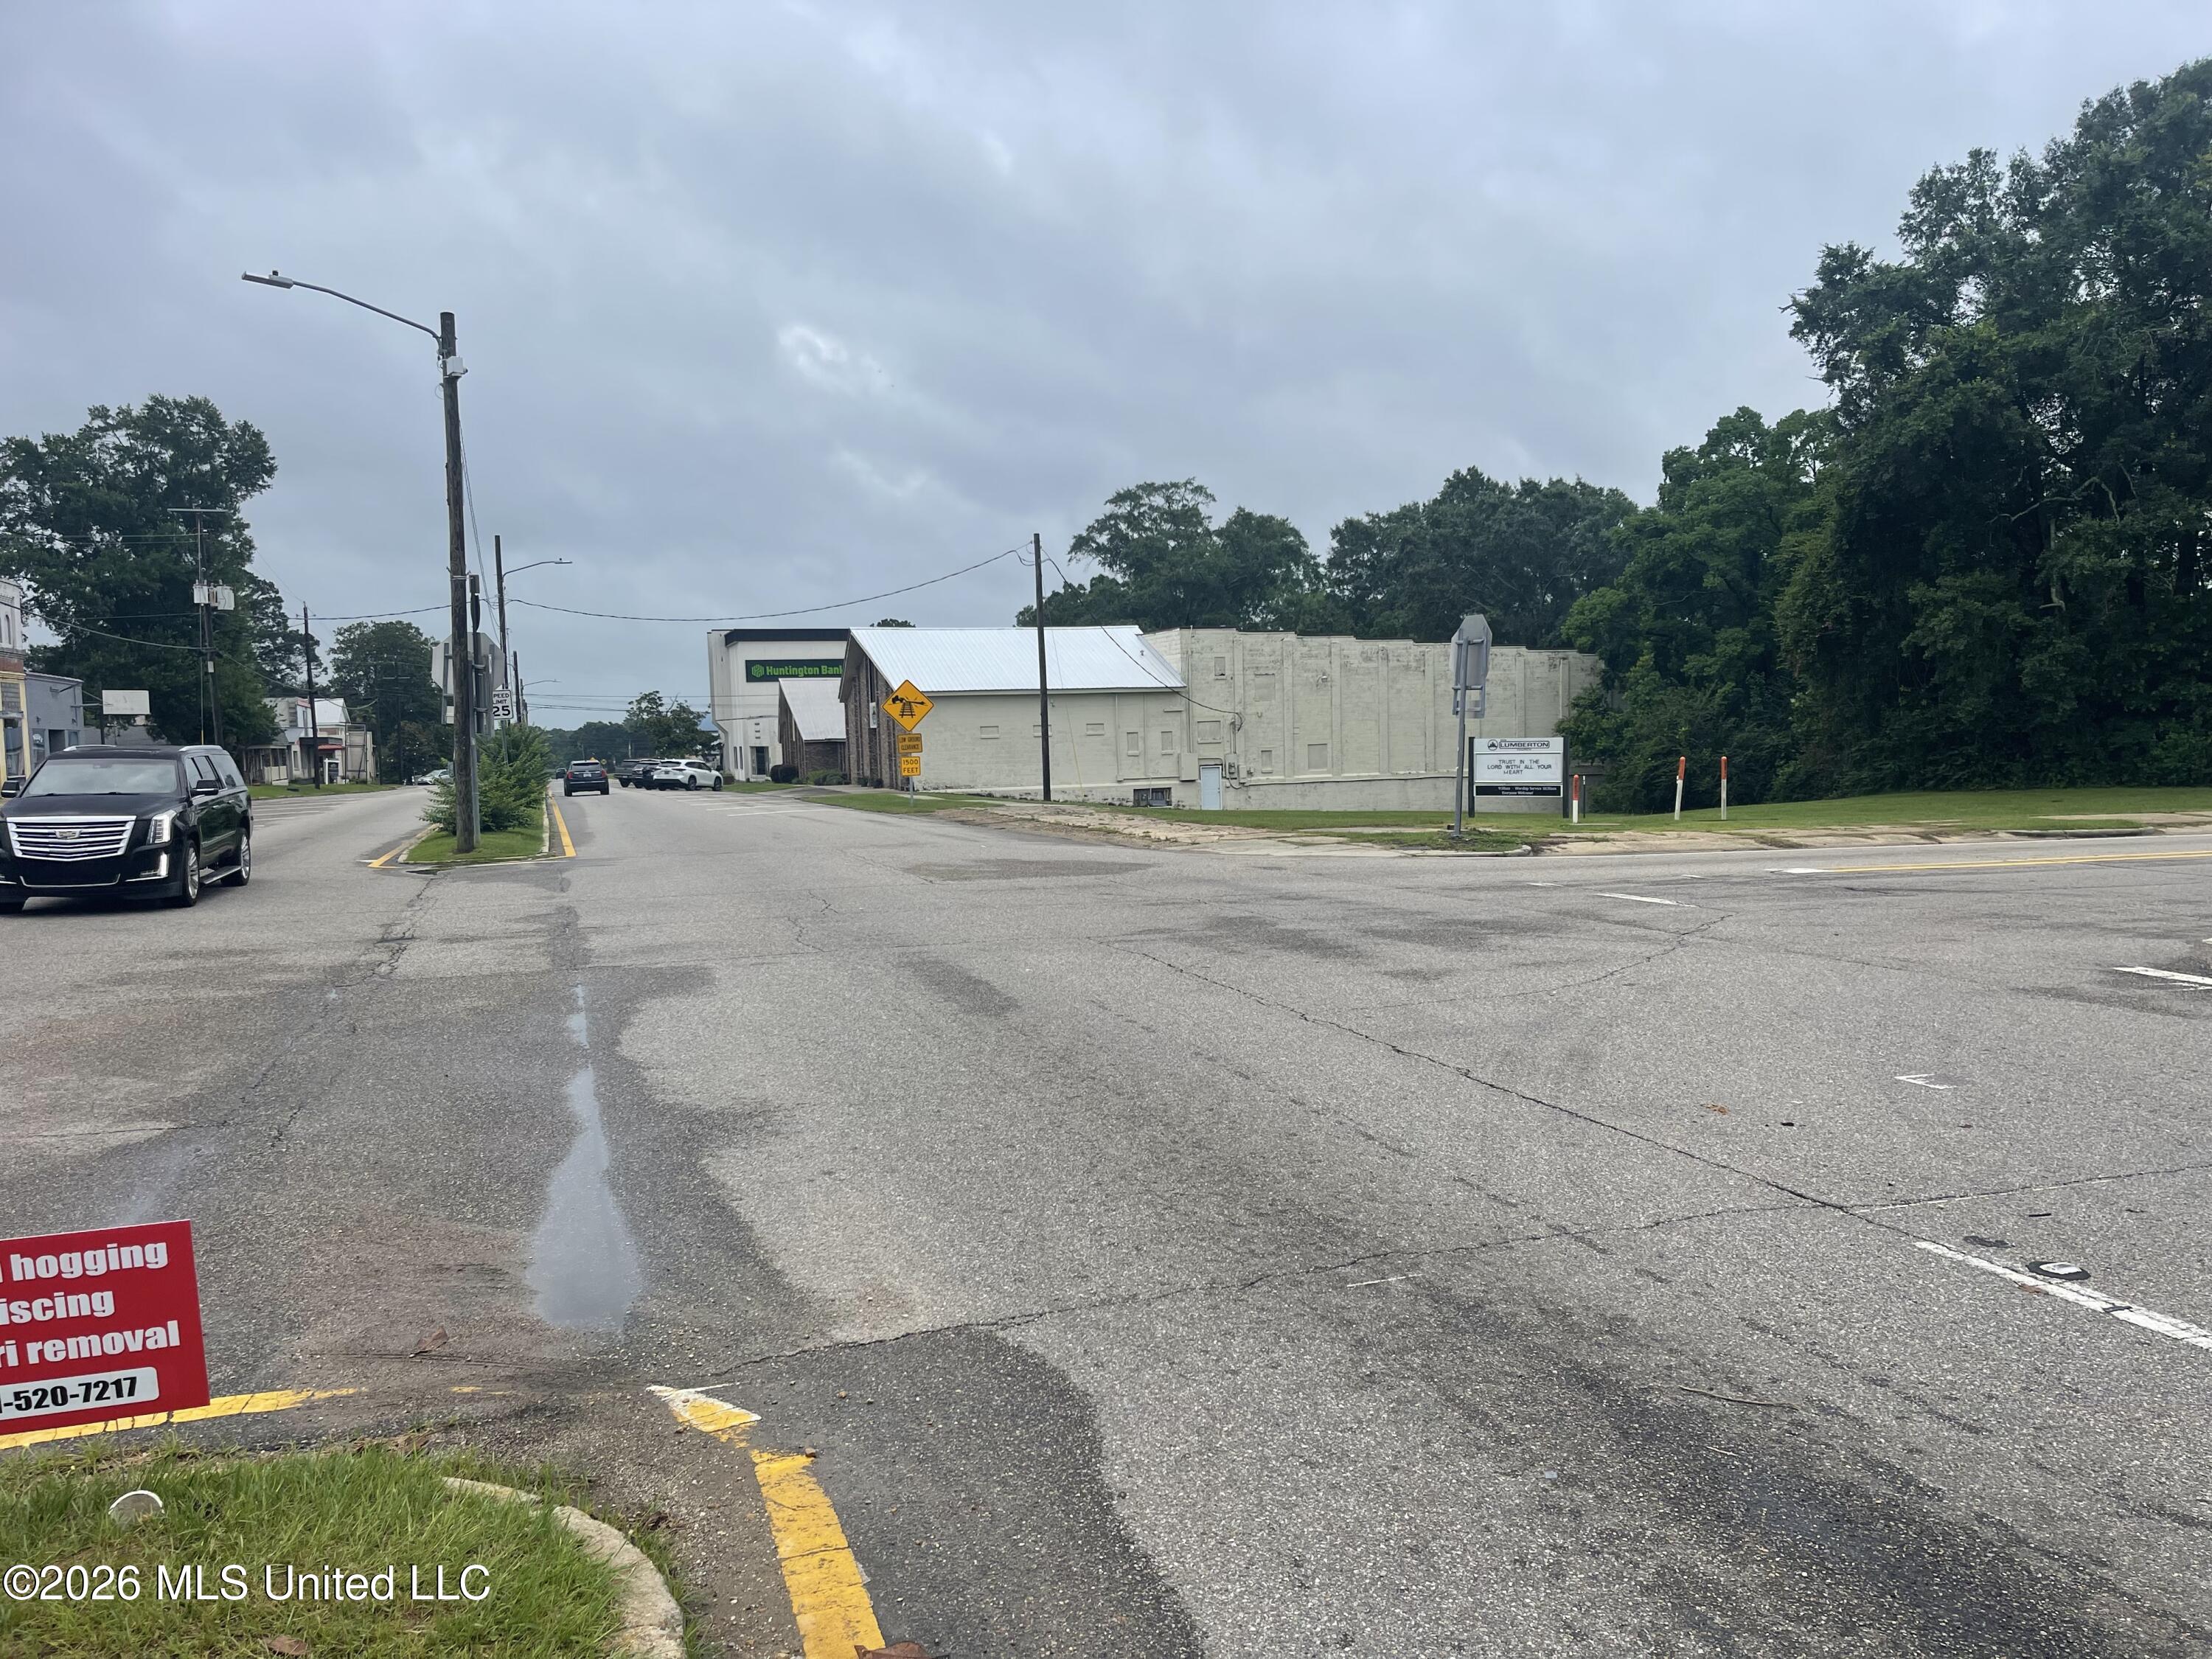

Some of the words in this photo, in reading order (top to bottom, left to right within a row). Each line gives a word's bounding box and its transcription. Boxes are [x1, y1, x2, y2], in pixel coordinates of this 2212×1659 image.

[766, 666, 819, 677] Huntington
[493, 706, 510, 716] 25
[10, 1242, 168, 1281] hogging
[26, 1320, 181, 1365] removal
[0, 1376, 137, 1413] -520-7217
